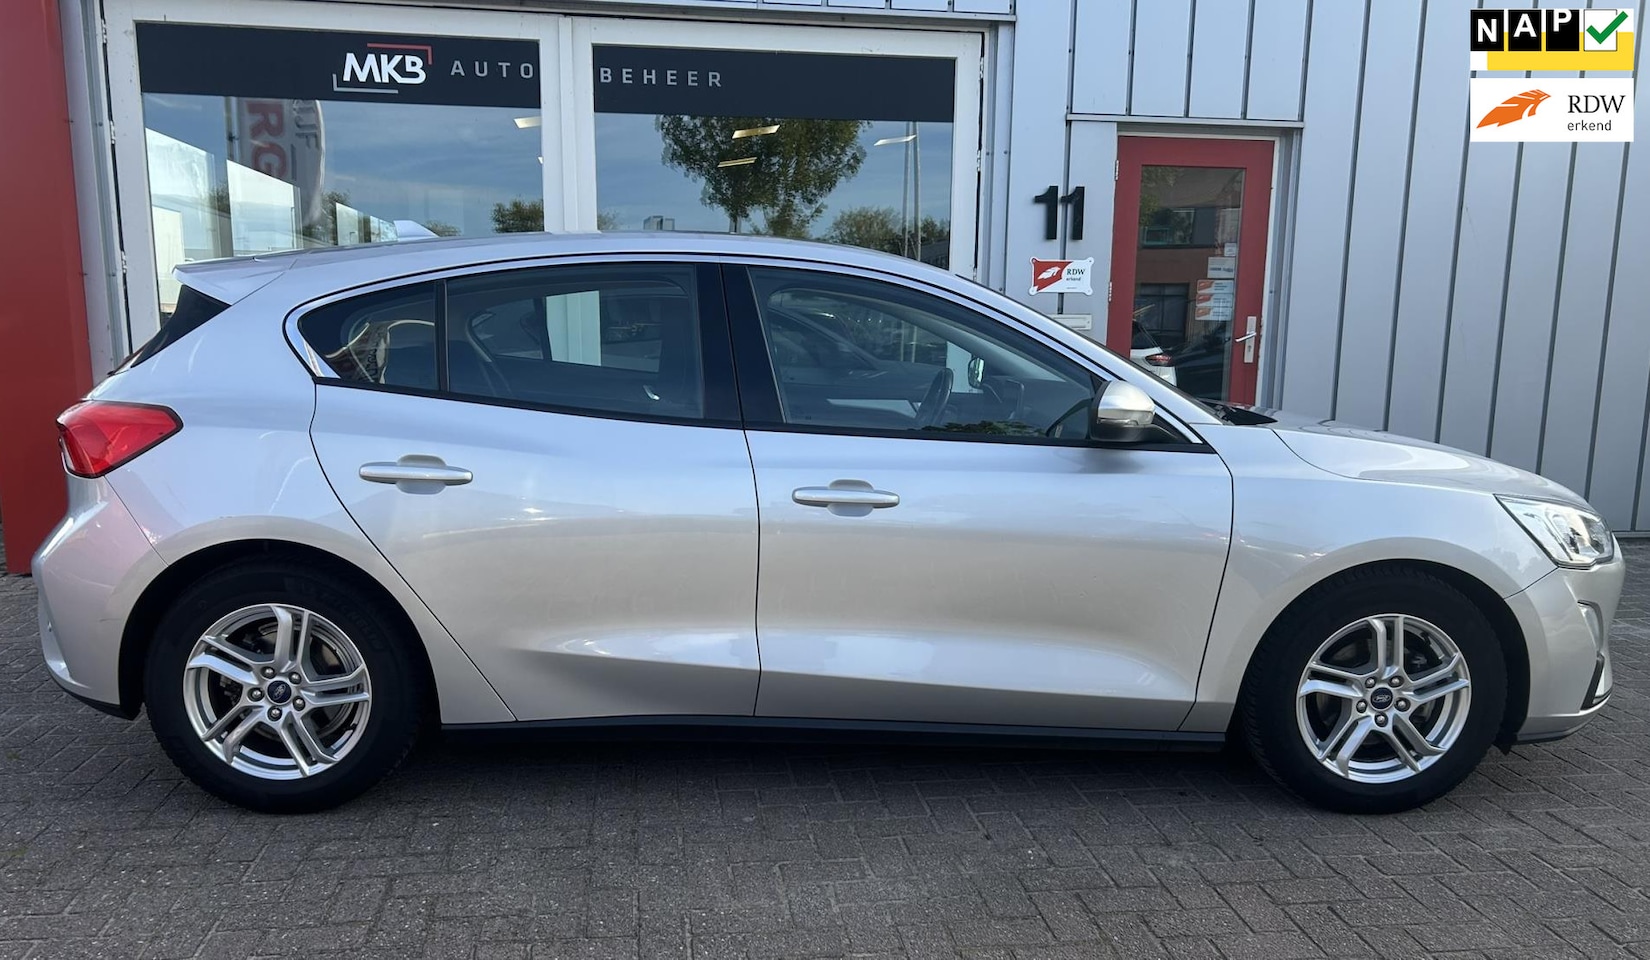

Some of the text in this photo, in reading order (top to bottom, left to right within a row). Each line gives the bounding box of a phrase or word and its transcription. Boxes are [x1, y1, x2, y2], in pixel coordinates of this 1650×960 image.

[342, 52, 722, 88] MKB AUTO BEHEER
[1033, 185, 1085, 241] 11
[1066, 268, 1086, 276] RDW
